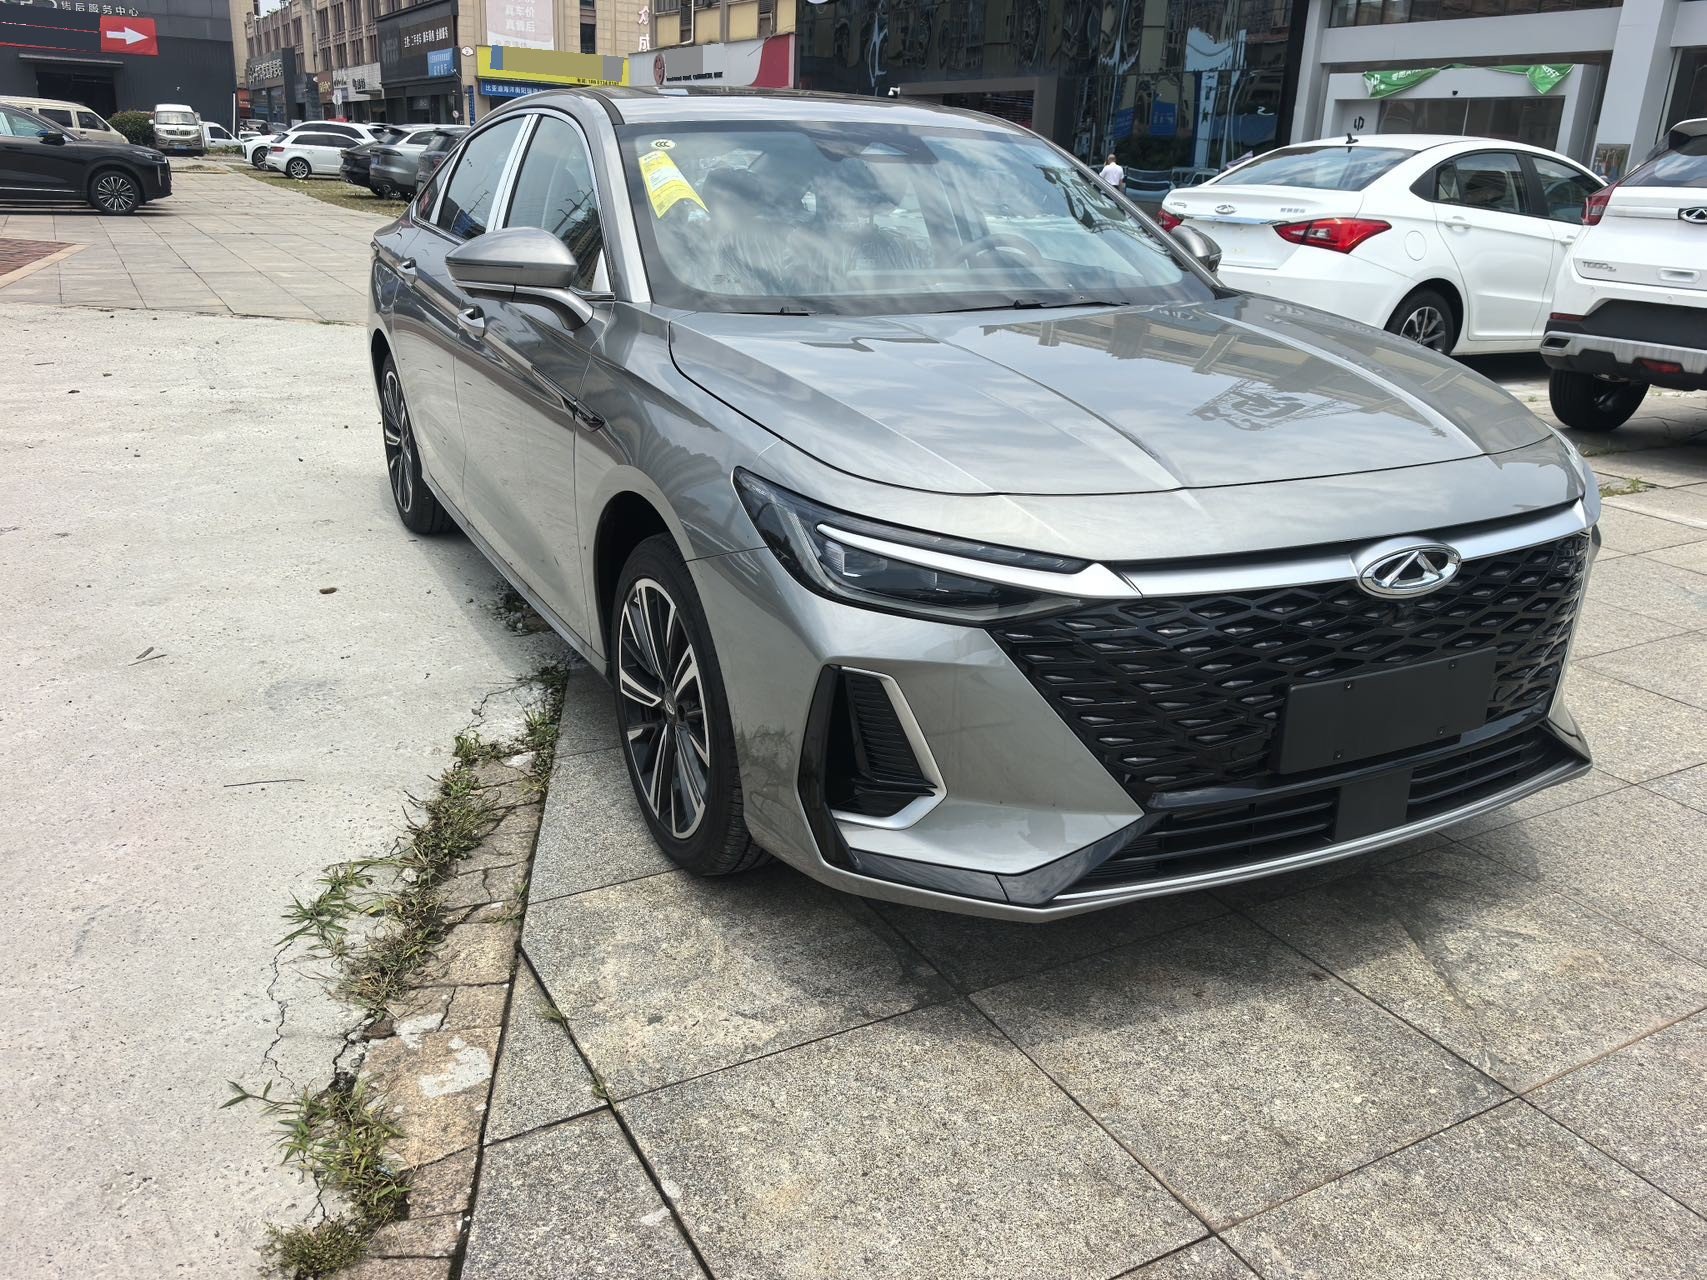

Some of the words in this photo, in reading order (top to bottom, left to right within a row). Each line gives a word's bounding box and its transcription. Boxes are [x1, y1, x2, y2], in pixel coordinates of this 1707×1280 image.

[61, 1, 139, 17] 售后服务中心
